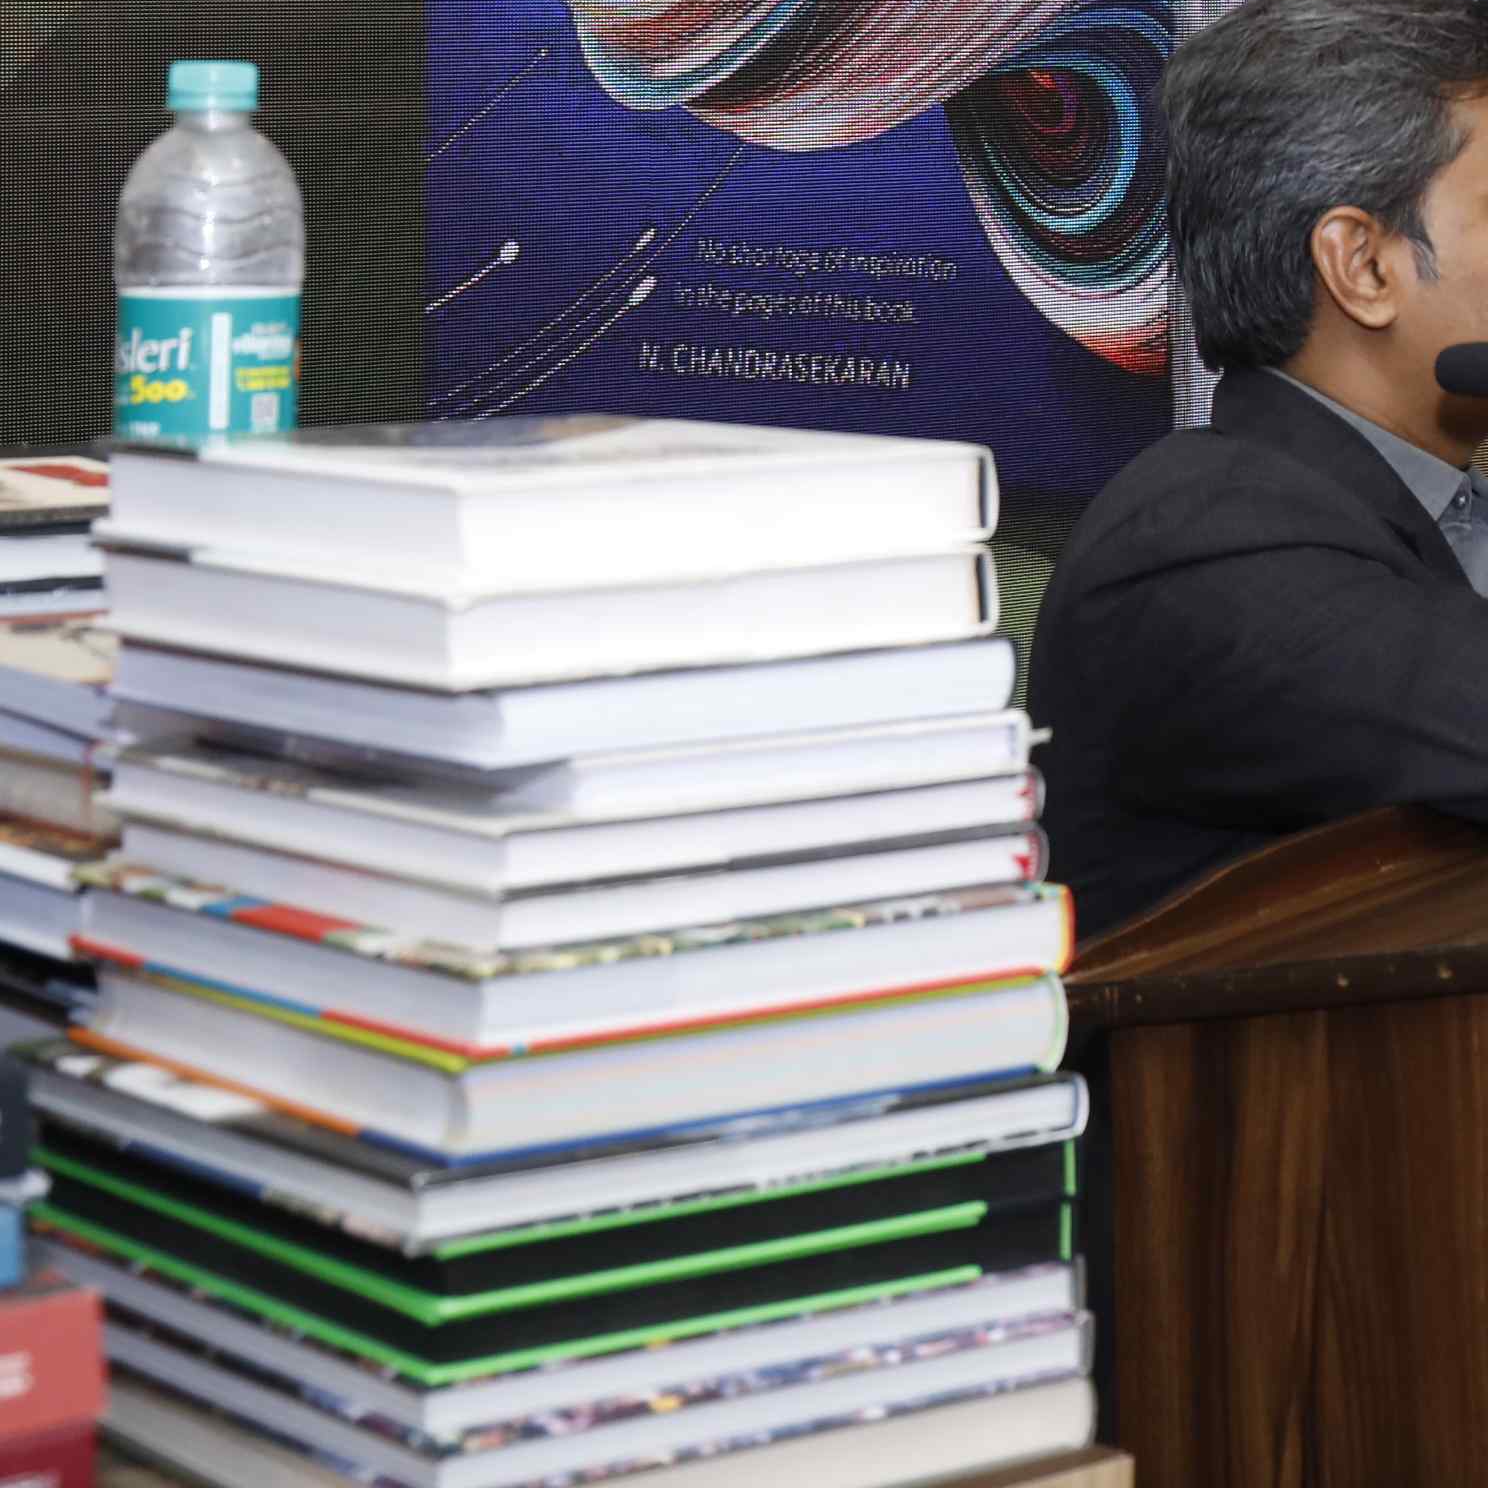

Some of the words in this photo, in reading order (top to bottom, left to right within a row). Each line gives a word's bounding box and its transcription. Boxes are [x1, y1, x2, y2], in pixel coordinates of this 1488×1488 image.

[698, 238, 724, 262] No
[730, 240, 819, 278] shortage
[824, 245, 848, 271] of
[849, 250, 957, 283] inspiration
[676, 281, 694, 307] in
[698, 282, 731, 312] the
[733, 291, 795, 322] pages
[799, 292, 822, 314] of
[822, 293, 861, 319] this
[115, 325, 193, 375] sleri
[639, 340, 666, 372] N.
[672, 342, 911, 390] CHANDRASEKARAN
